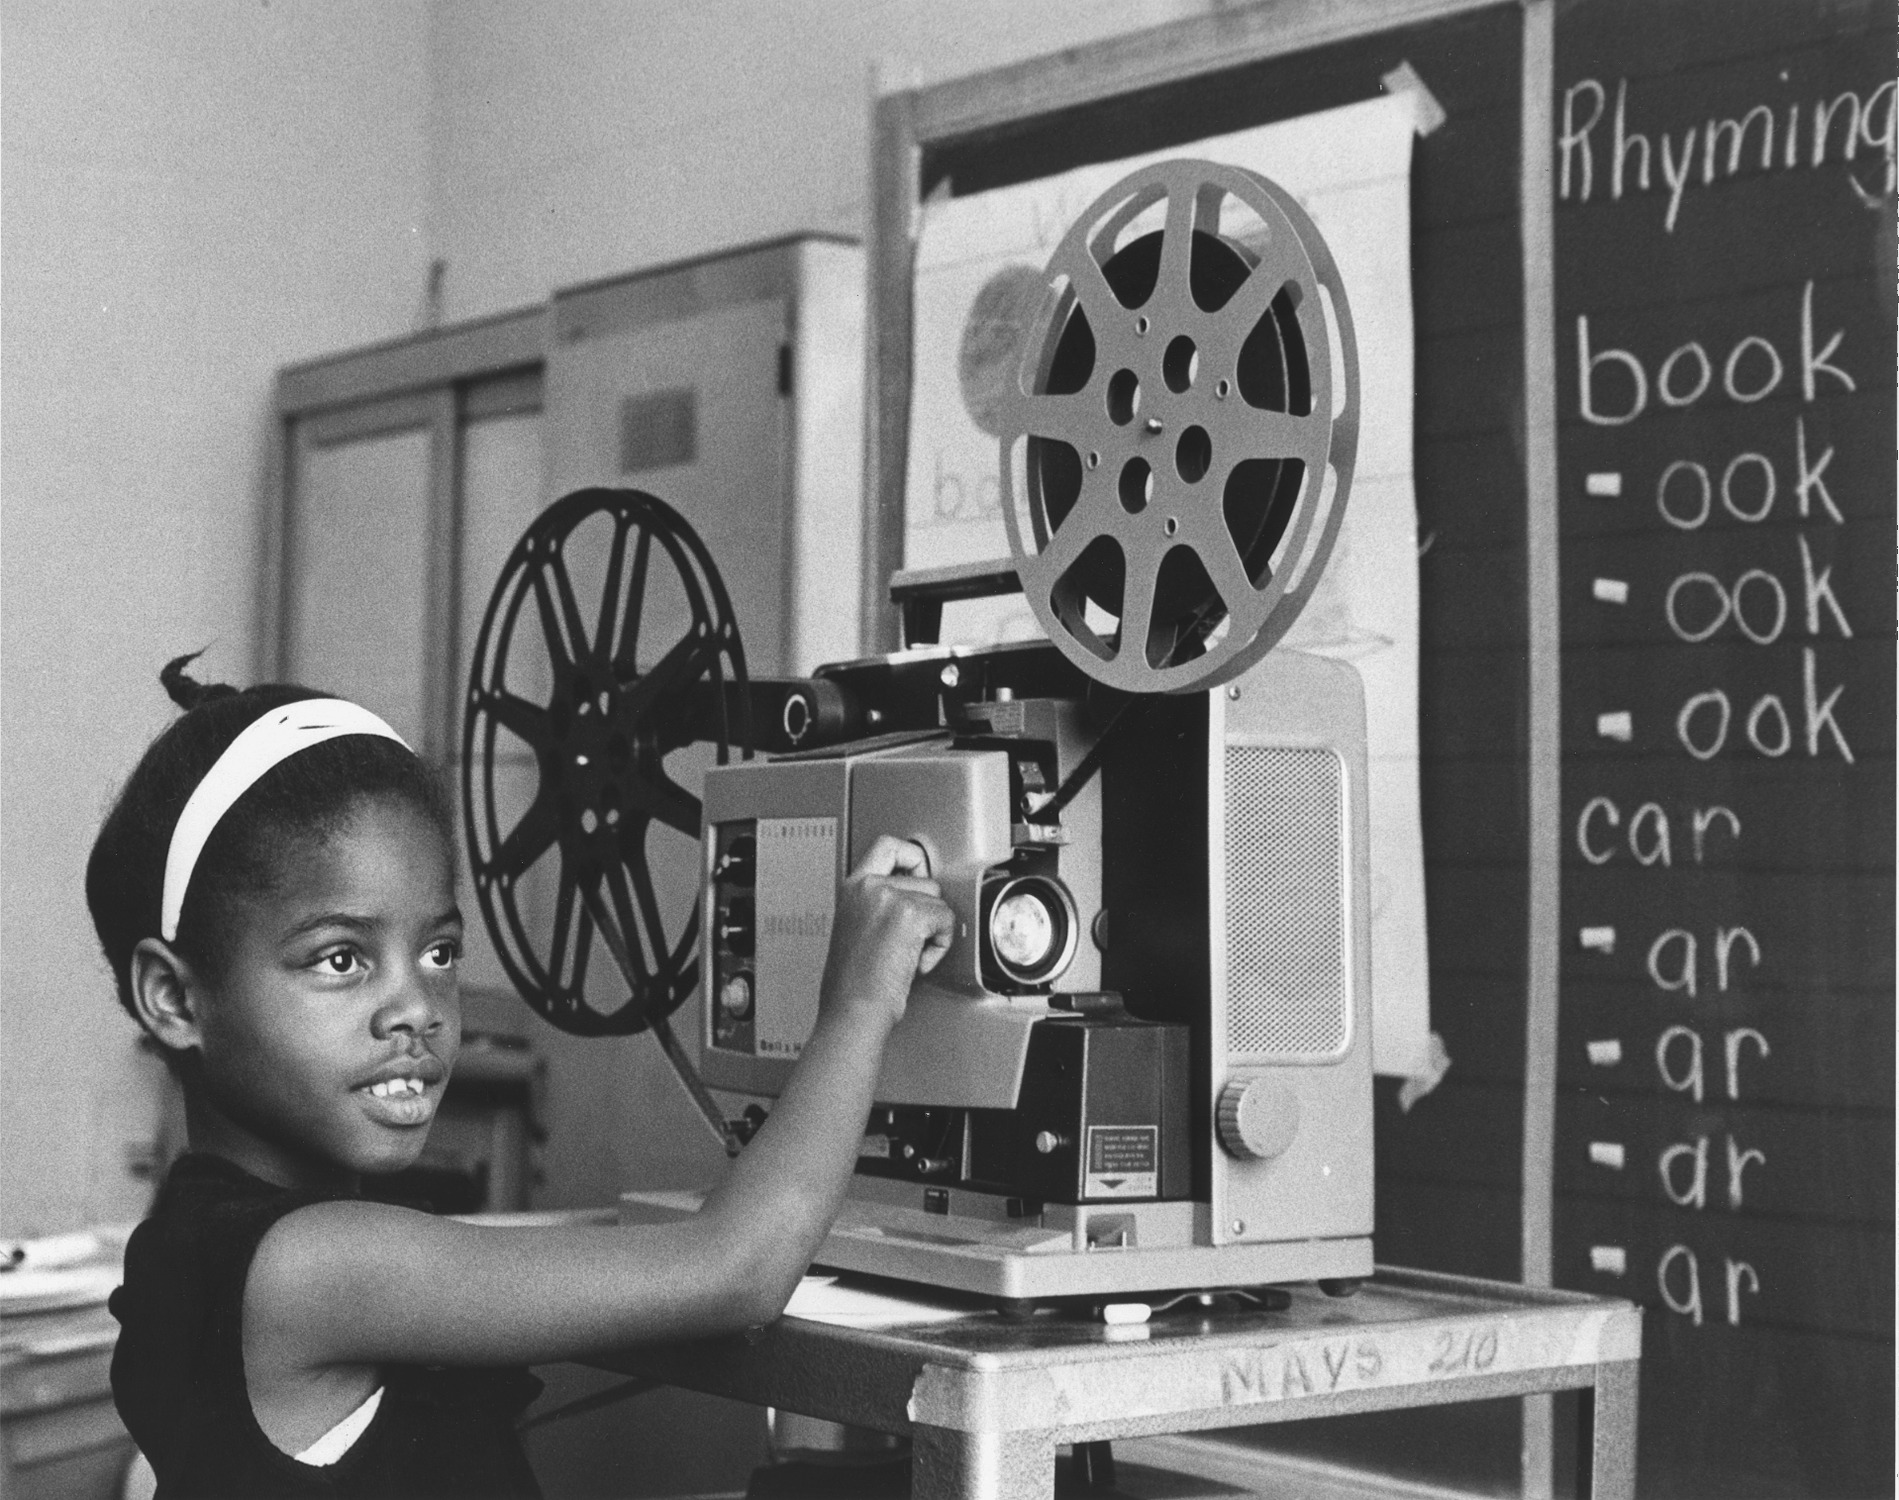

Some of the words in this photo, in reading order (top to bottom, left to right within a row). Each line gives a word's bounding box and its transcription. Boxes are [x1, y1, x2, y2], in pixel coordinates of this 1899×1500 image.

[1558, 71, 1897, 233] Rhyming
[1576, 280, 1856, 426] book
[1657, 415, 1845, 530] ook
[1665, 534, 1853, 645] ook
[1676, 647, 1855, 764] ook
[1576, 796, 1741, 867] car
[1647, 926, 1761, 998] ar
[1655, 1025, 1770, 1103] ar
[1657, 1244, 1760, 1326] ar
[1220, 1341, 1383, 1404] MAYS
